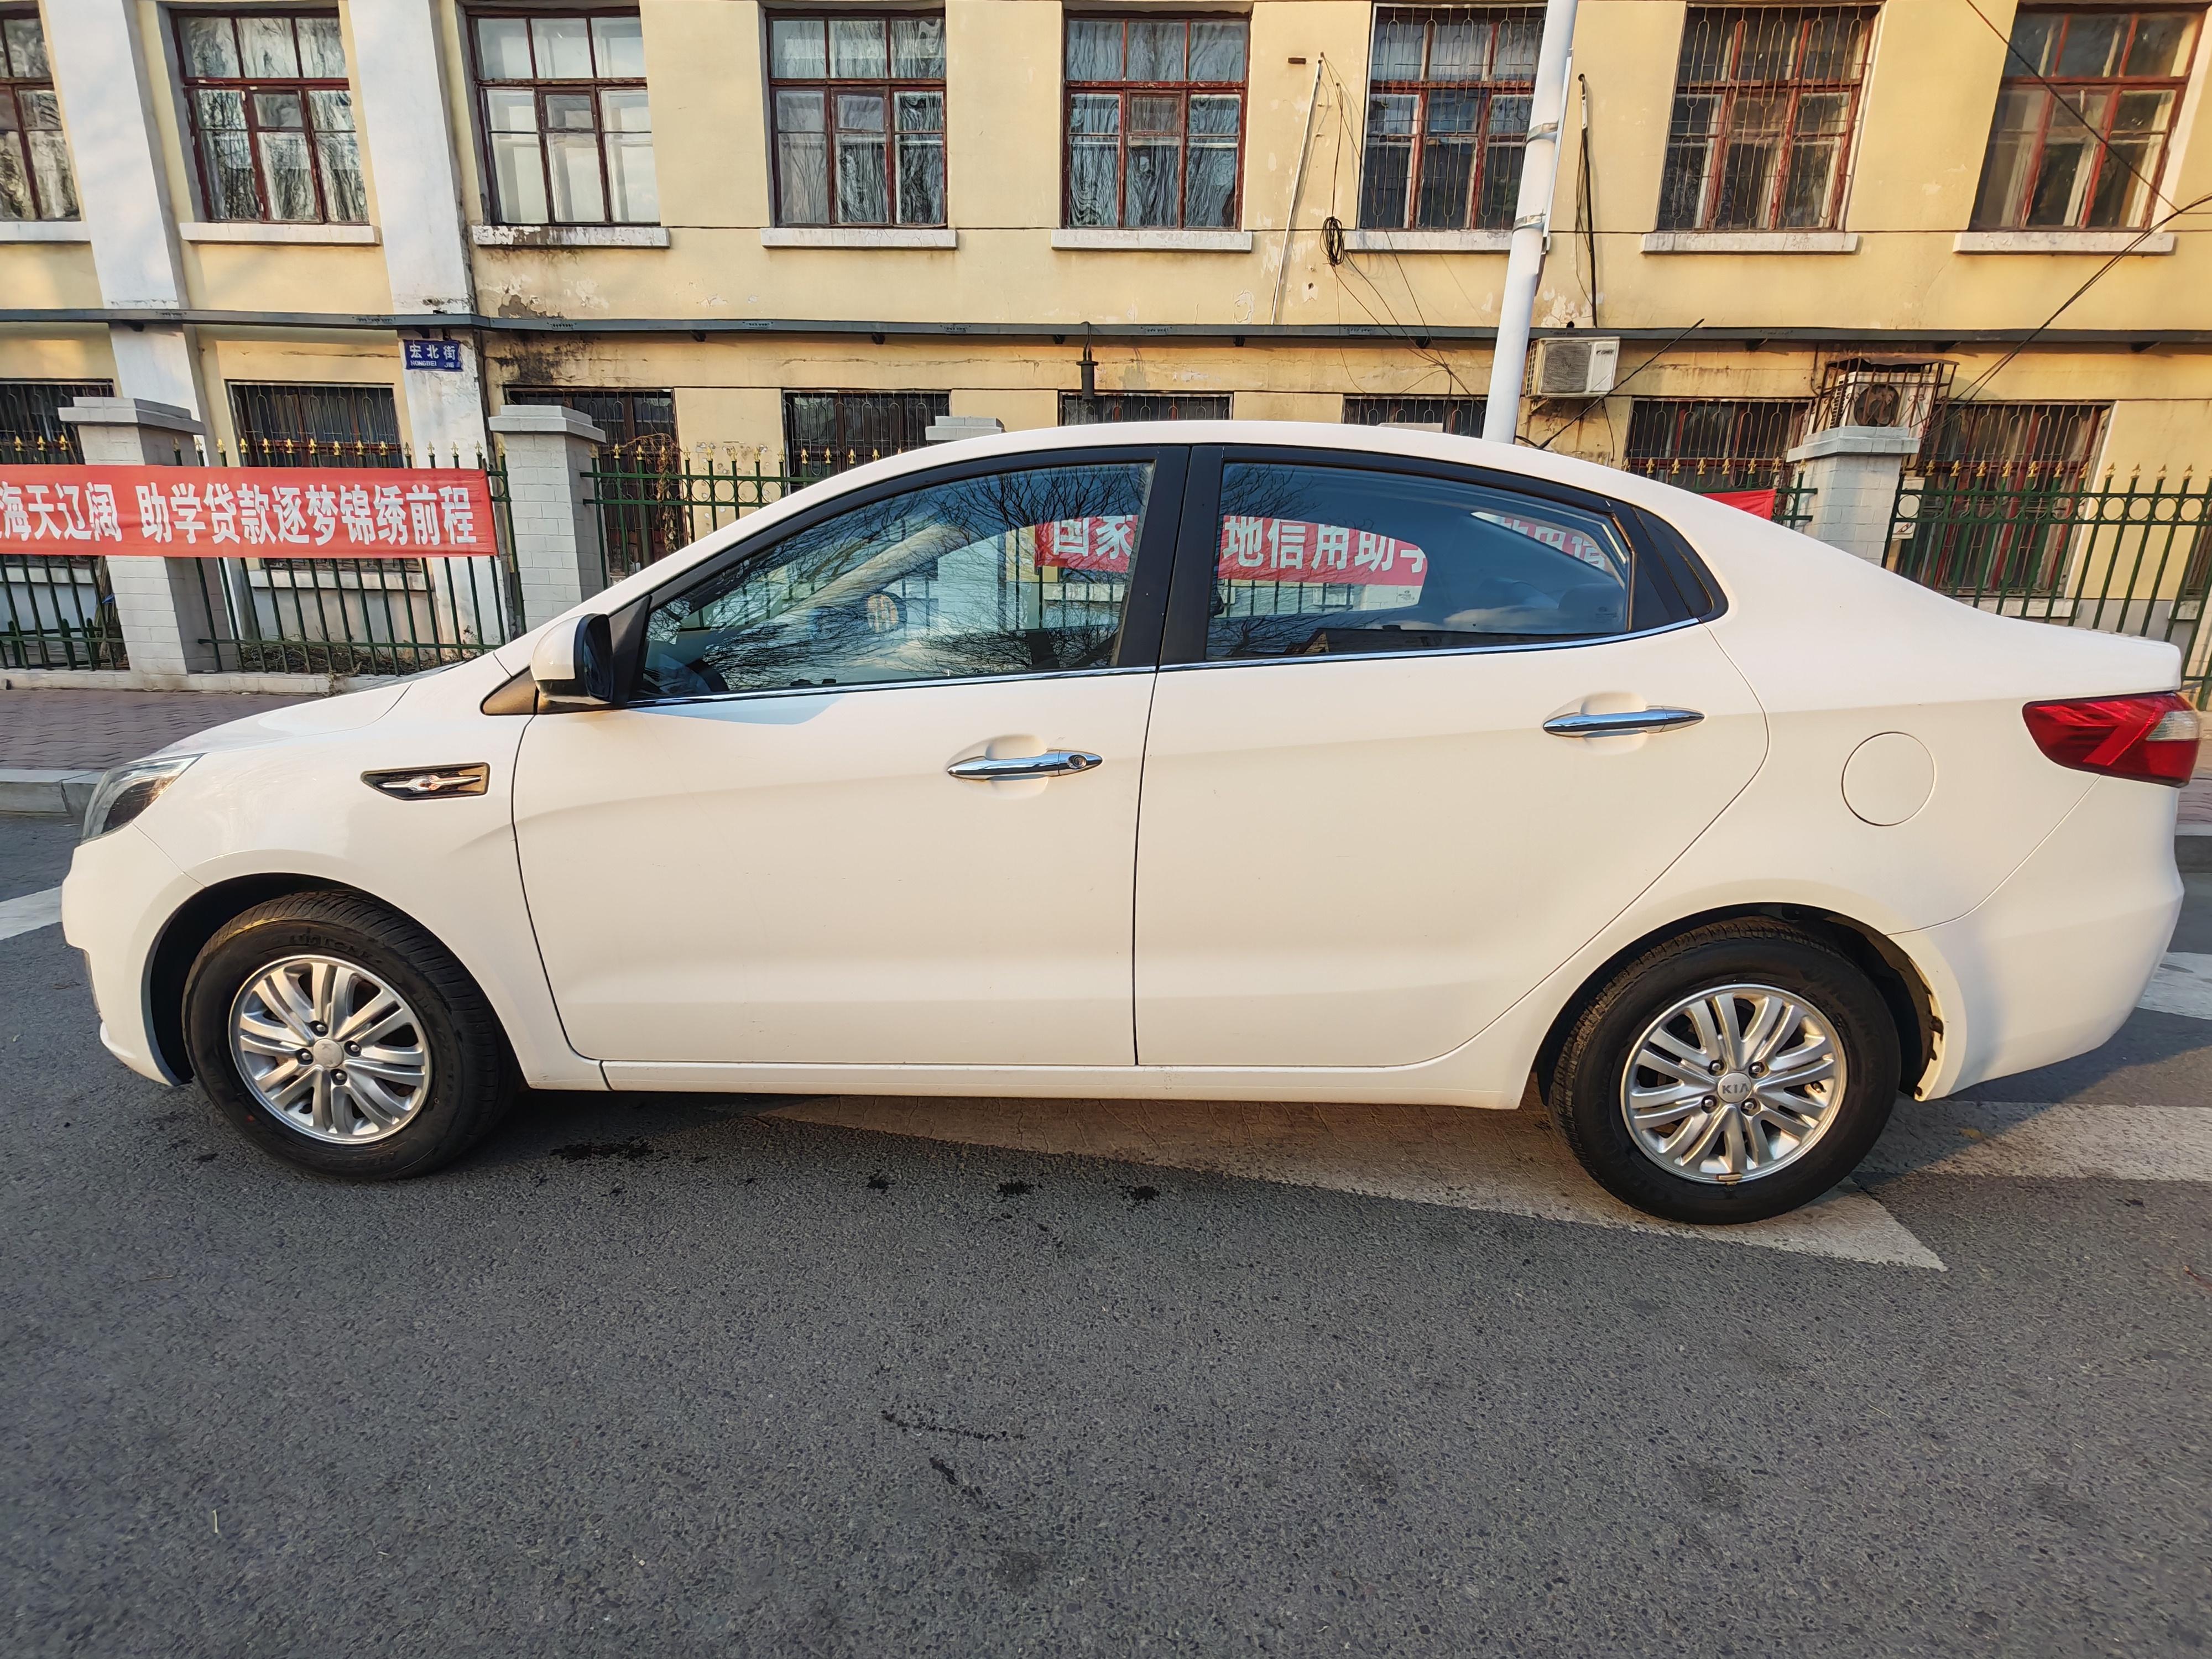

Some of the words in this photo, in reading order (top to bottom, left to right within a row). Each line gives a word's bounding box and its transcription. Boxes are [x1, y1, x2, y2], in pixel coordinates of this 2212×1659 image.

[410, 344, 455, 360] 宏北街
[0, 481, 122, 541] 海天辽阔
[135, 482, 477, 546] 助学贷款逐梦锦绣前程
[1053, 515, 1133, 560] 国家
[1722, 1083, 1749, 1094] KIA
